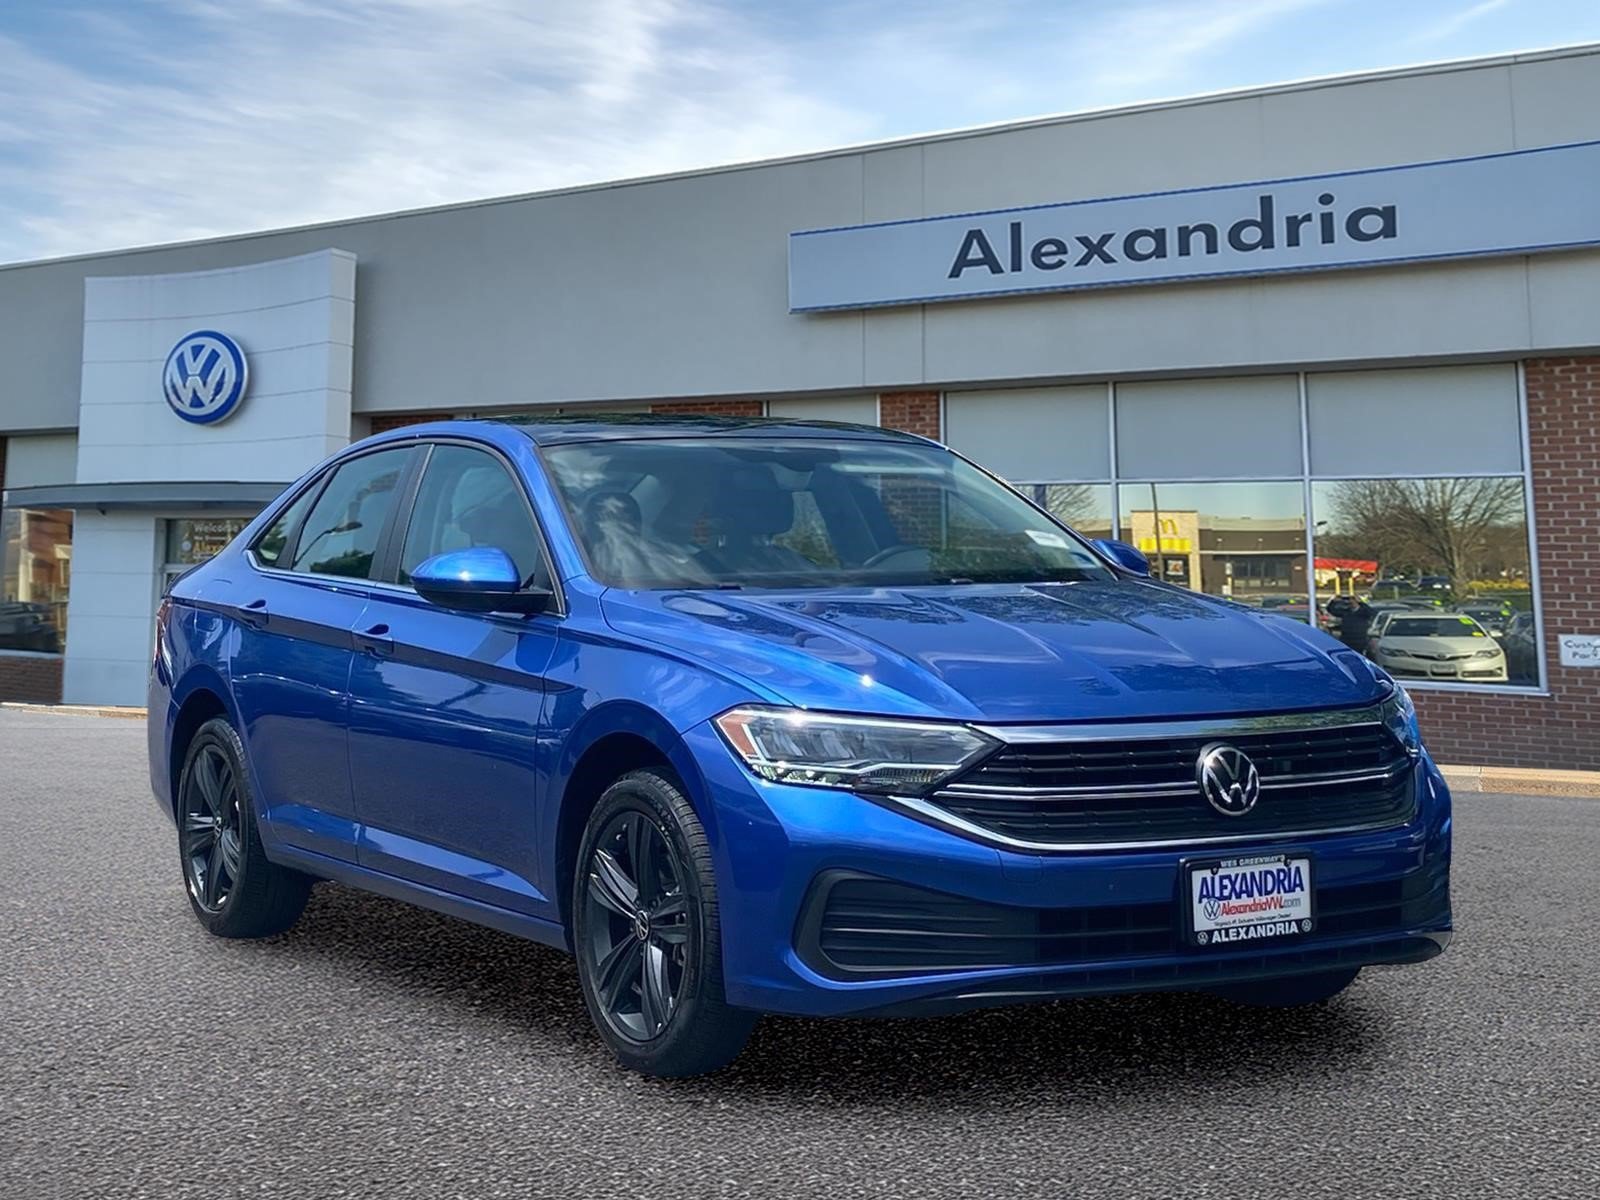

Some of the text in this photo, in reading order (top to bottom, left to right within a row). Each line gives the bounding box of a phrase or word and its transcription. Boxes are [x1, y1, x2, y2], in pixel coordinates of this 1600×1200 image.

[947, 192, 1398, 280] Alexandria
[1198, 866, 1304, 903] ALEXANDRIA
[1211, 921, 1299, 943] ALEXANDRIA
